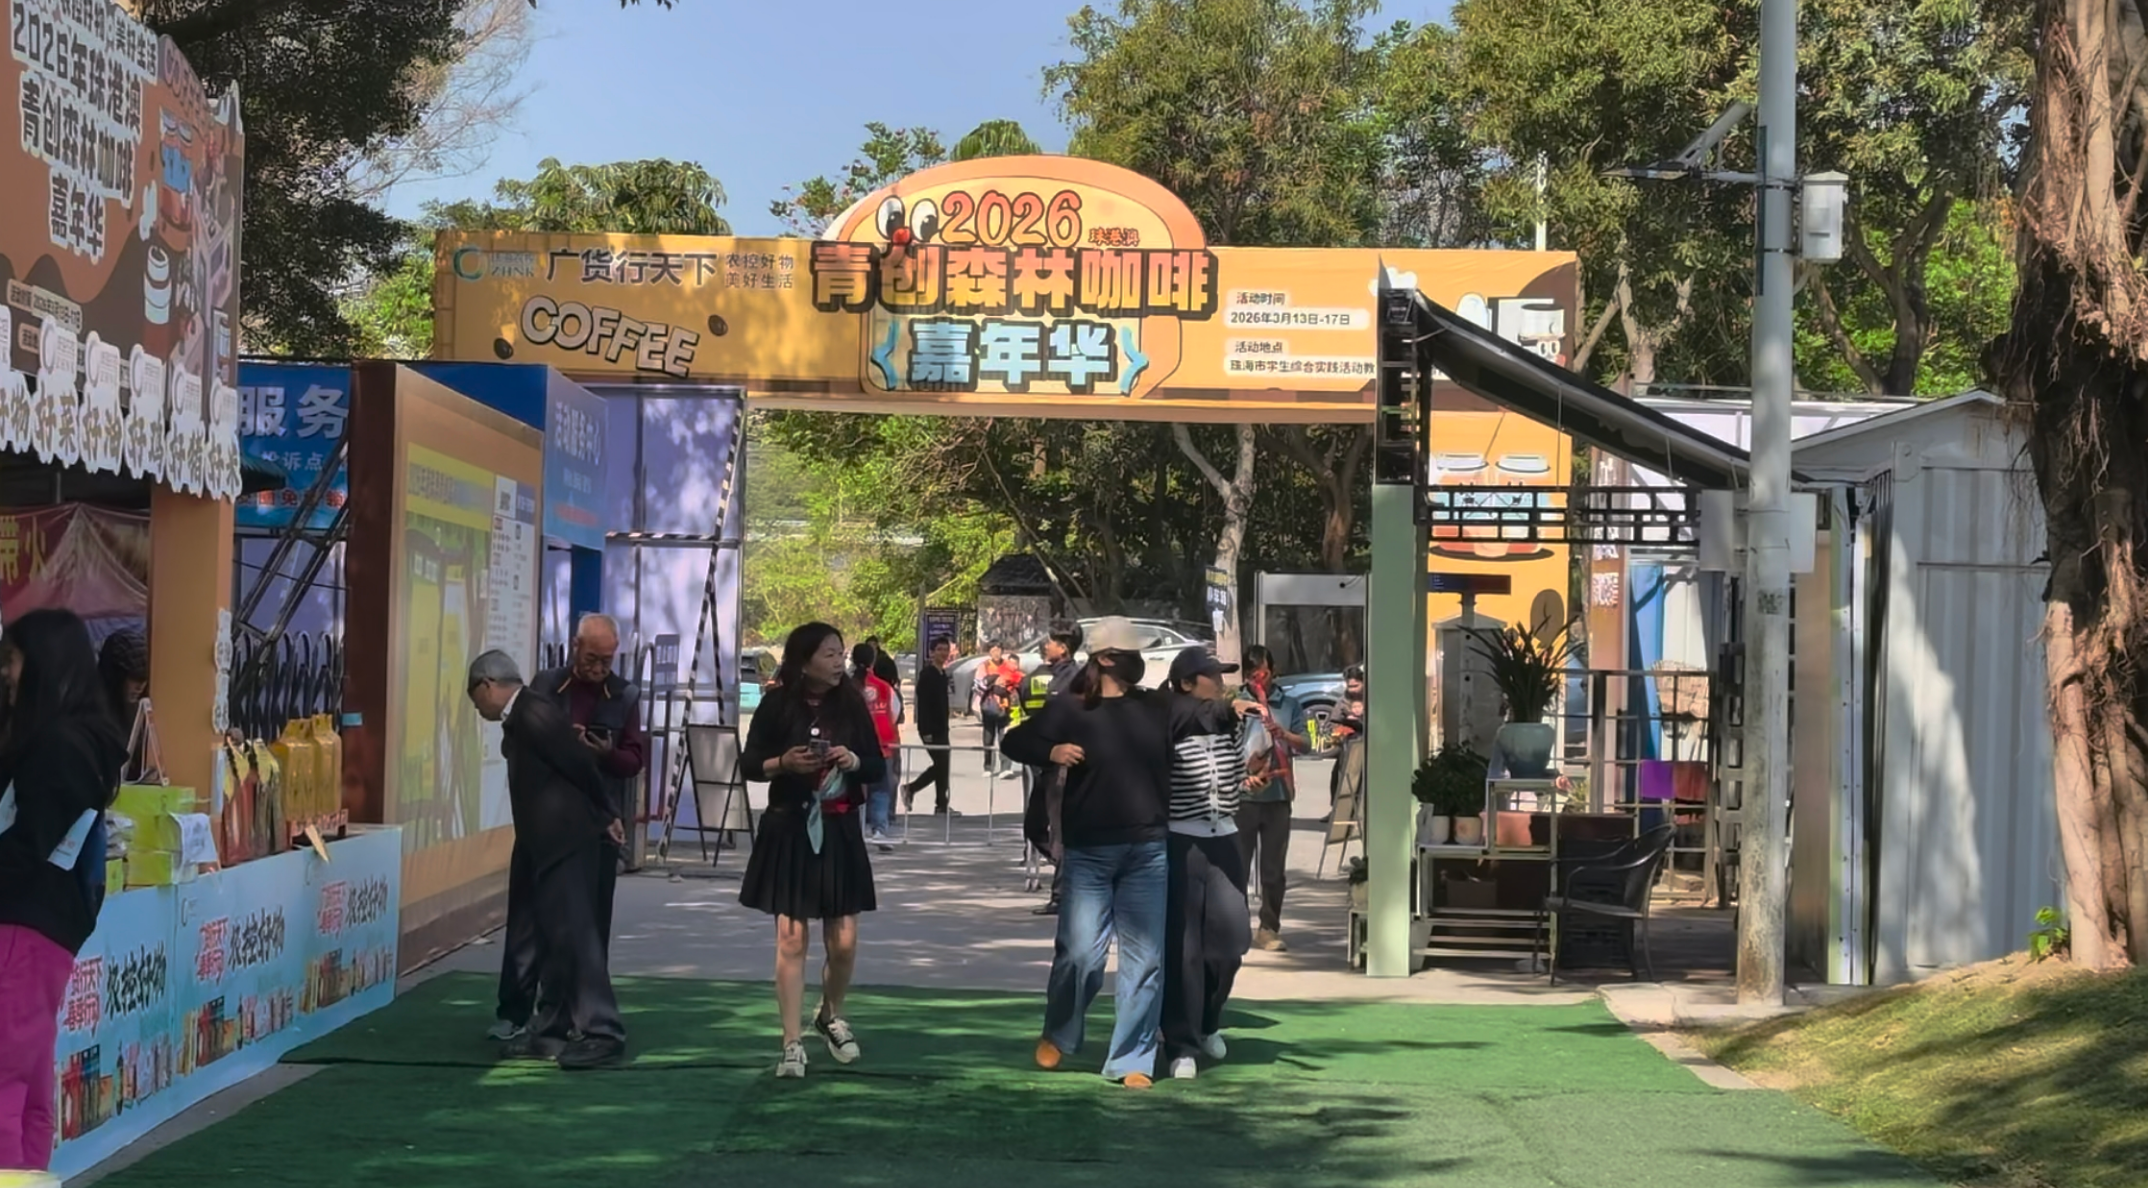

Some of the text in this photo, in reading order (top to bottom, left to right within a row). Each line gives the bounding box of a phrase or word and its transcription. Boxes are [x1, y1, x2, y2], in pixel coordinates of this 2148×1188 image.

[13, 3, 141, 138] 2026年珠港澳
[21, 78, 134, 203] 青创森林咖啡
[50, 172, 103, 253] 嘉年华
[939, 190, 1082, 247] 2026
[547, 249, 717, 285] 广货行天下
[725, 253, 794, 271] 农控好物
[725, 272, 794, 289] 美好生活
[812, 243, 1214, 316] 青创森林咖啡
[1231, 312, 1350, 325] 2026年3月13日-17日
[1236, 292, 1286, 305] 活动时间
[520, 295, 699, 378] COFFEE
[910, 320, 1113, 389] 嘉年华
[1235, 341, 1283, 354] 活动地点
[238, 384, 349, 438] 服务
[228, 905, 286, 970] 农控好物
[104, 945, 167, 1020] 农控好物
